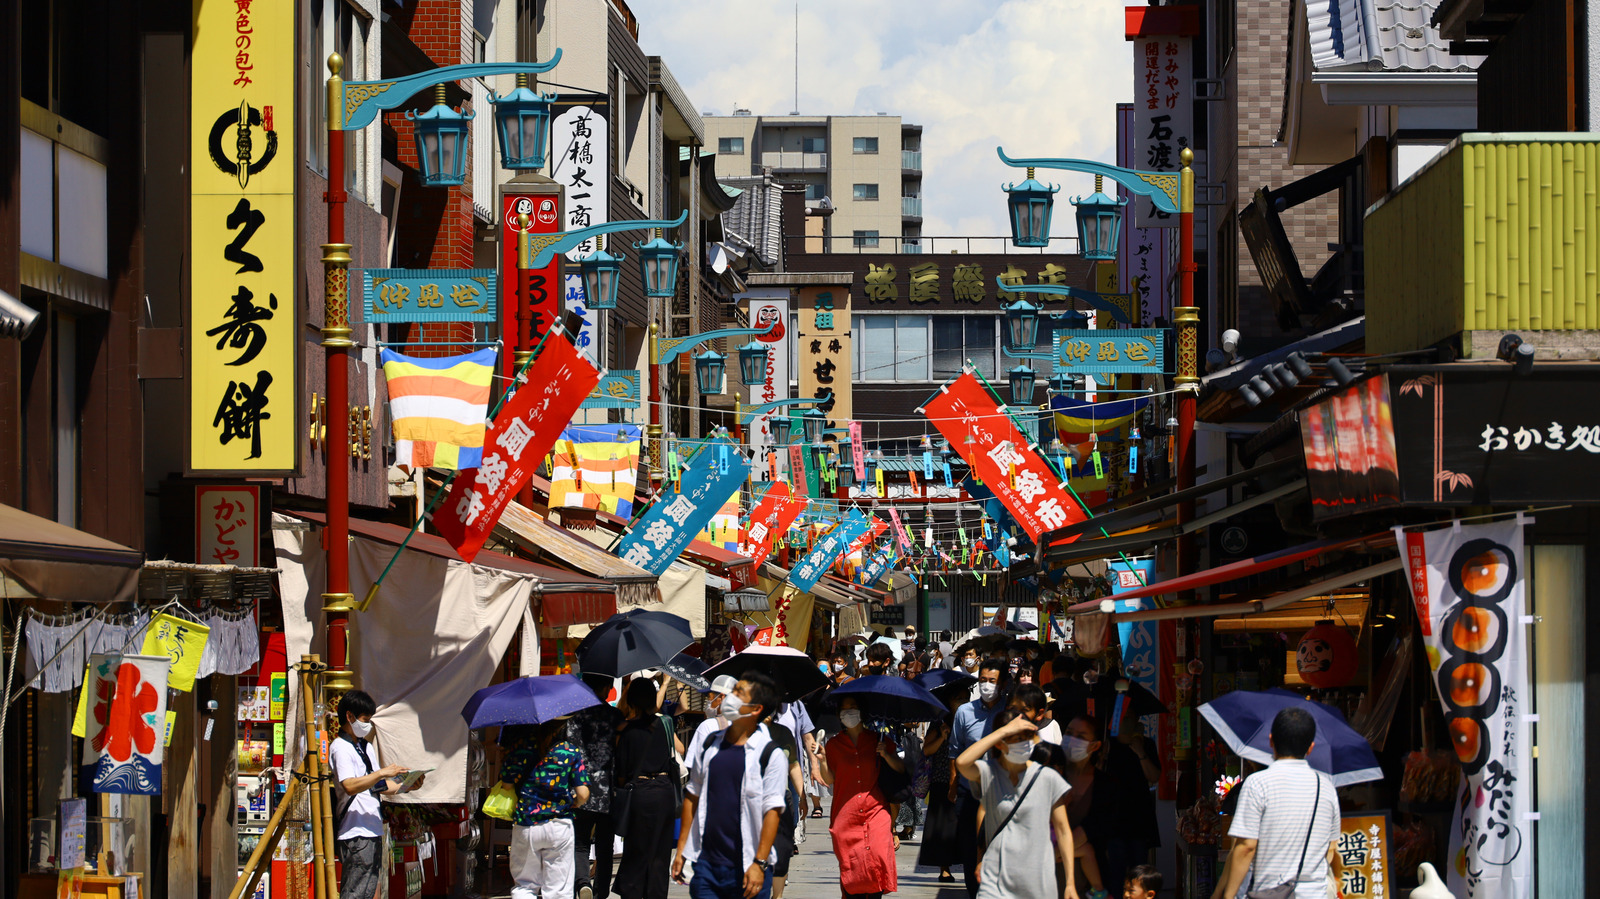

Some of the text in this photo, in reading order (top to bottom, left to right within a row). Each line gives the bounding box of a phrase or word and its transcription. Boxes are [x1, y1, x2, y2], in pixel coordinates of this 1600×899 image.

[1145, 42, 1160, 109] 開運だるま
[1165, 42, 1180, 109] おみやげ
[380, 283, 480, 309] 仲見世
[814, 291, 834, 331] 元祖
[1065, 340, 1150, 362] 仲見世
[213, 497, 247, 564] かどや
[91, 663, 158, 762] 氷
[1477, 759, 1522, 866] みたらし
[1338, 832, 1368, 895] 醤油
[1368, 824, 1385, 899] 寺子屋本舗特
